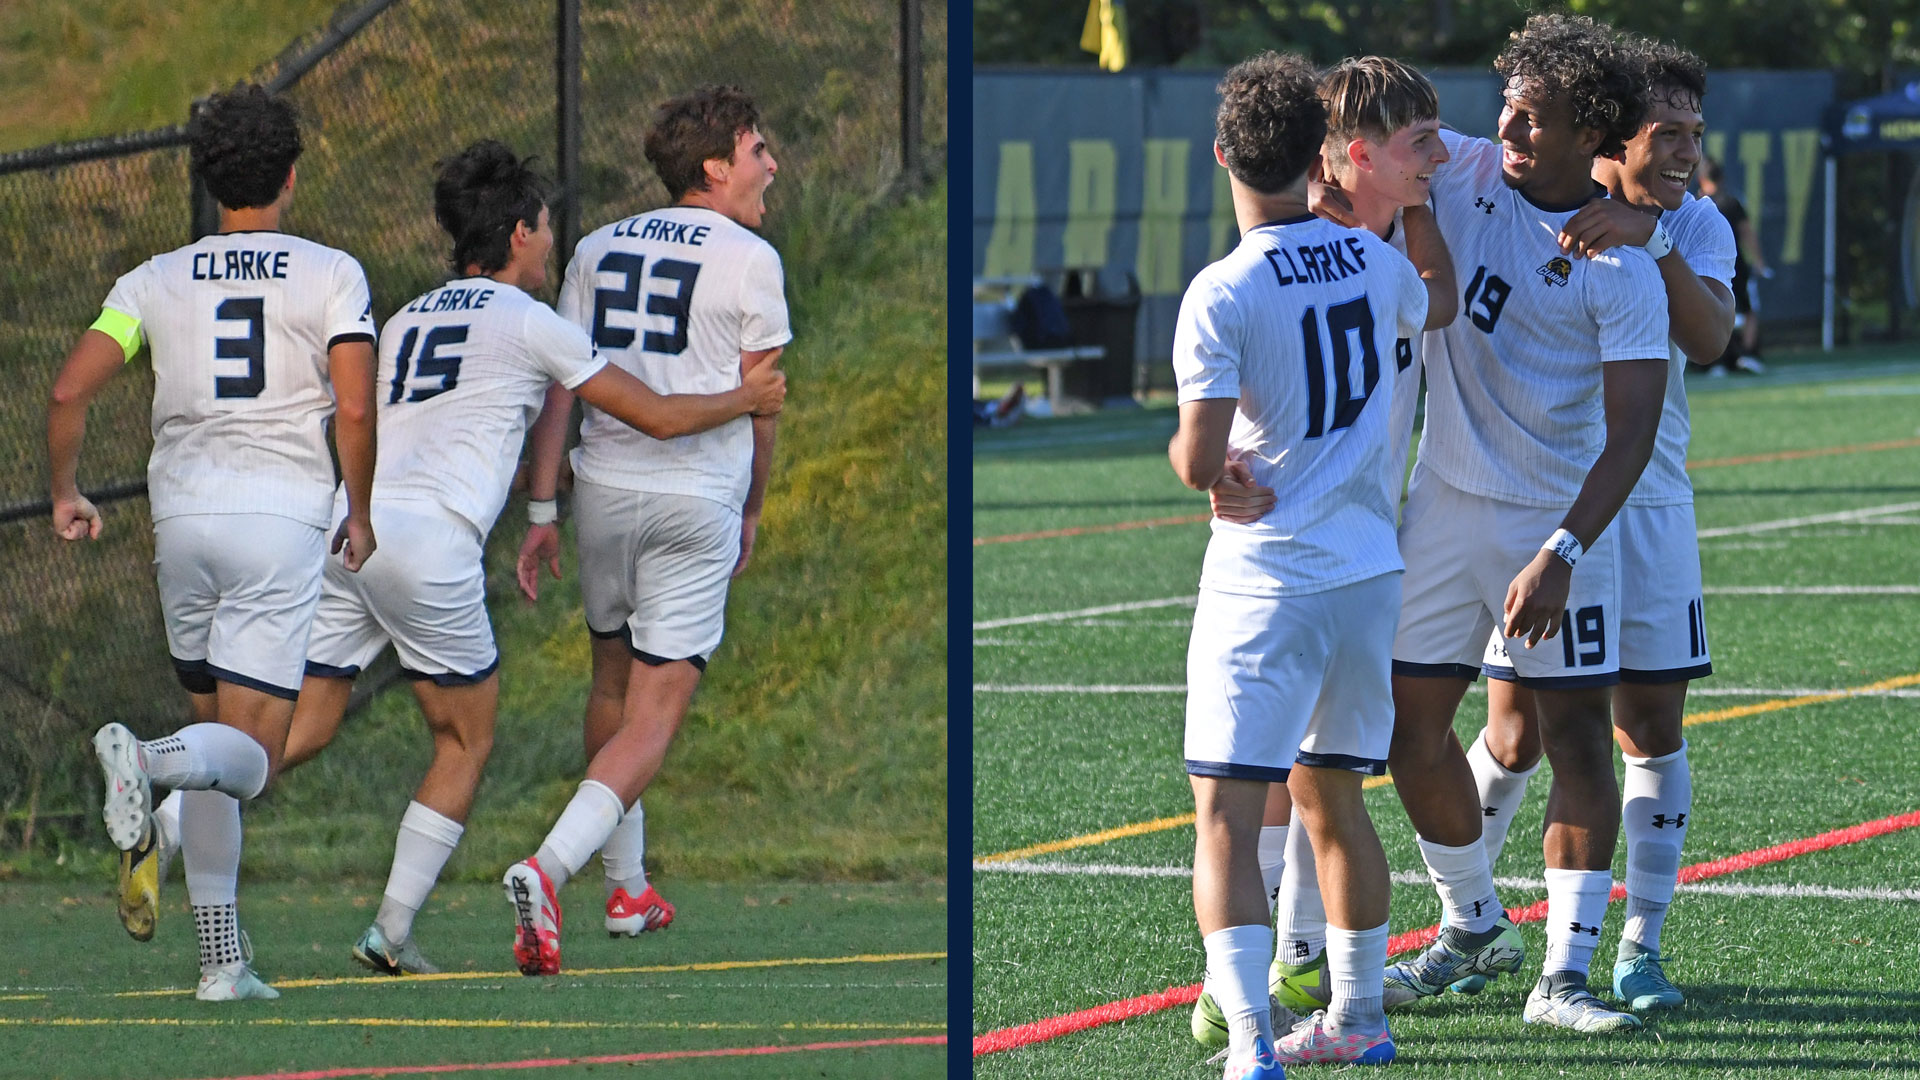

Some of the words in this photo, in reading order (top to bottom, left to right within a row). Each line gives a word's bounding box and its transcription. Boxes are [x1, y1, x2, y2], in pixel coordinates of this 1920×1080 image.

[612, 218, 711, 247] CLARKE
[1264, 237, 1366, 287] CLARKE
[193, 250, 290, 281] CLARKE
[1537, 265, 1568, 287] CLARKE
[407, 288, 496, 313] CLARKE
[592, 251, 703, 356] 23
[1464, 264, 1512, 334] 19
[215, 297, 265, 400] 3
[389, 324, 470, 405] 15
[1301, 290, 1380, 441] 10
[1561, 604, 1606, 668] 19
[1688, 597, 1706, 659] 11
